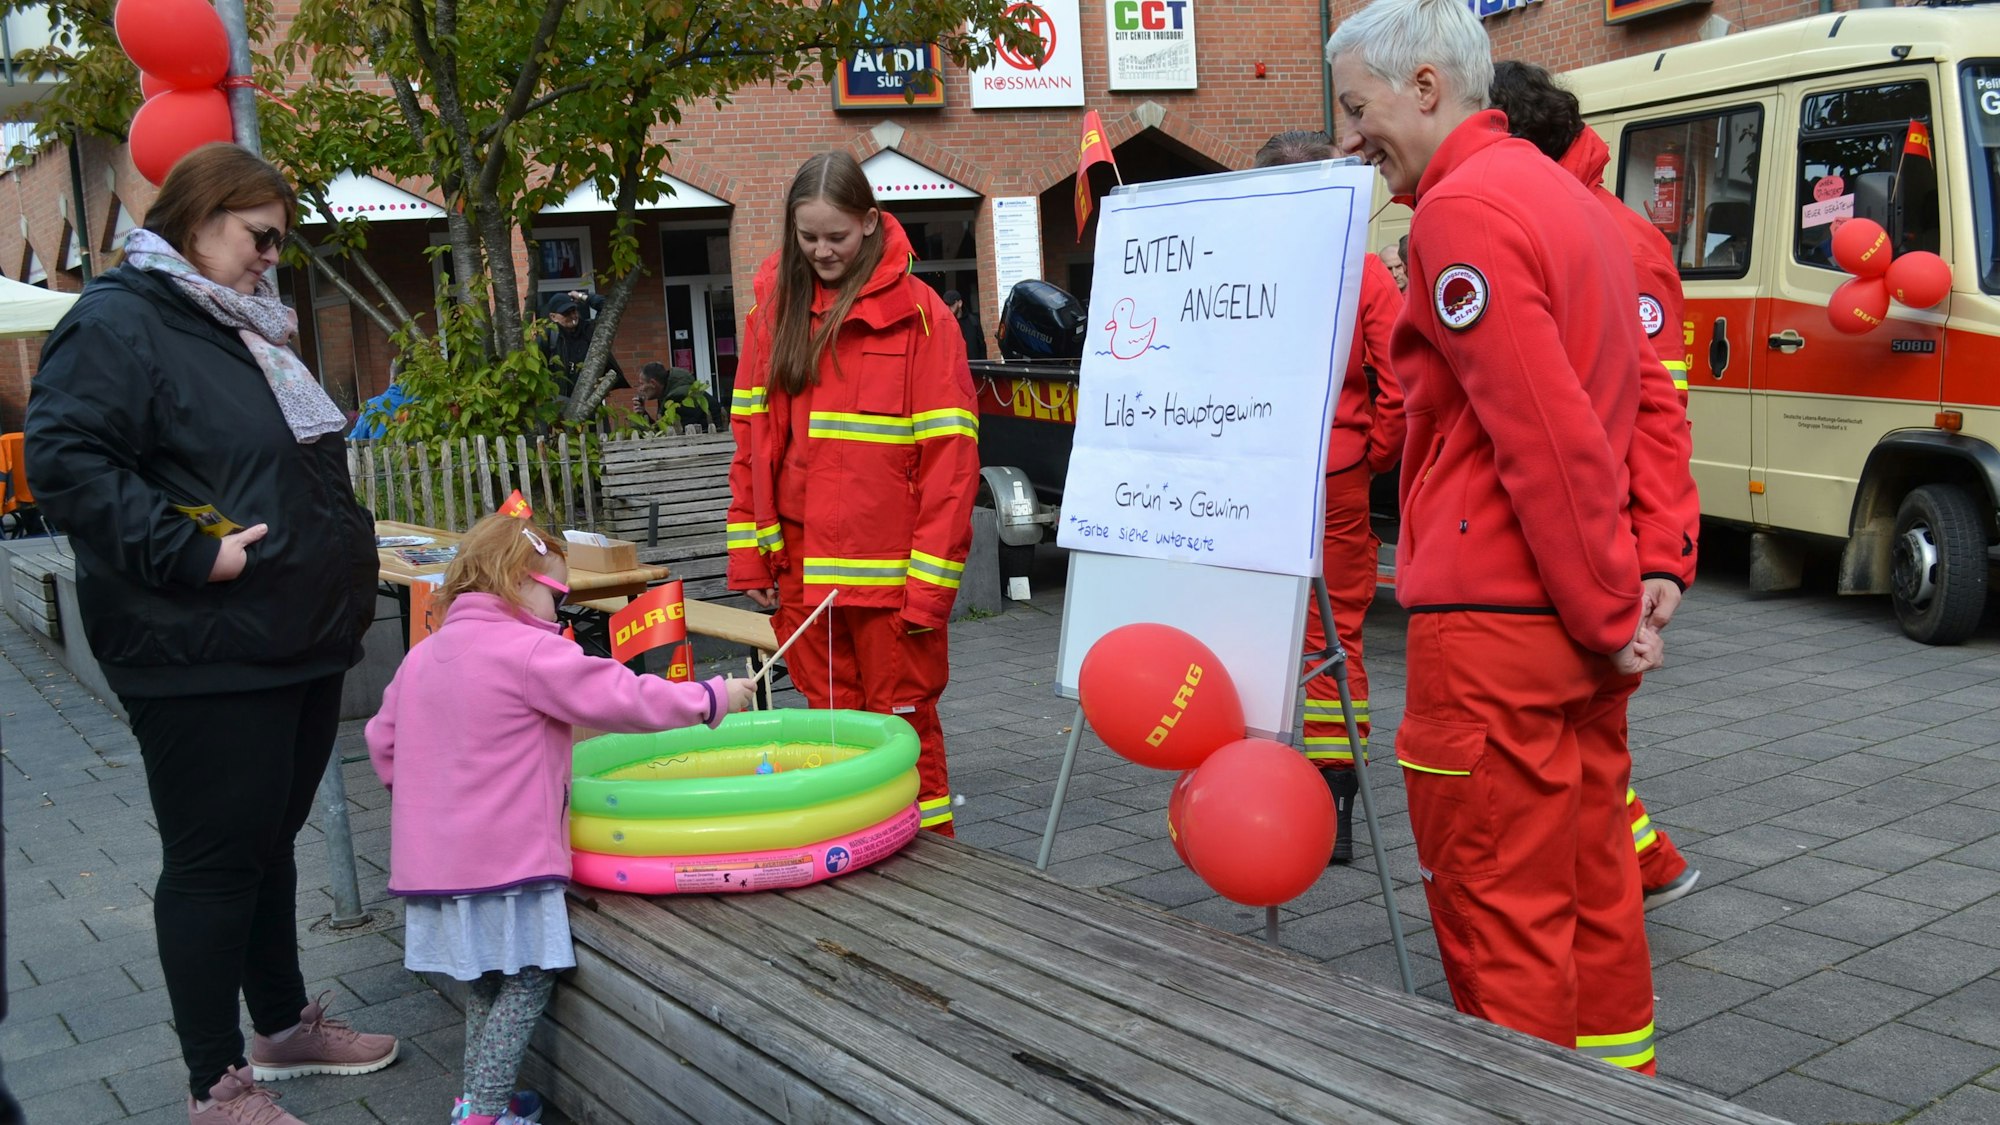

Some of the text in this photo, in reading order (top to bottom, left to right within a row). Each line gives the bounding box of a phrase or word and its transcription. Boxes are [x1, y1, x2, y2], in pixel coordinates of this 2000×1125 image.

[1114, 1, 1187, 30] CCT
[1115, 31, 1184, 40] CITY CENTER TROISDORF
[853, 48, 925, 72] ALDI
[984, 76, 1072, 91] ROSSMANN
[1976, 79, 2000, 90] Peli
[1860, 231, 1886, 261] DLRG
[1180, 282, 1277, 322] ANGELN
[1454, 305, 1479, 323] DLRG
[1016, 321, 1053, 344] TOHATSU
[1012, 378, 1079, 421] DLR
[1164, 392, 1272, 437] Hauptgewinn
[1190, 490, 1250, 520] Gewinn
[1119, 526, 1149, 543] siehe
[1156, 531, 1215, 552] unterseite
[615, 602, 685, 647] DLRG
[1145, 663, 1203, 747] DLRG
